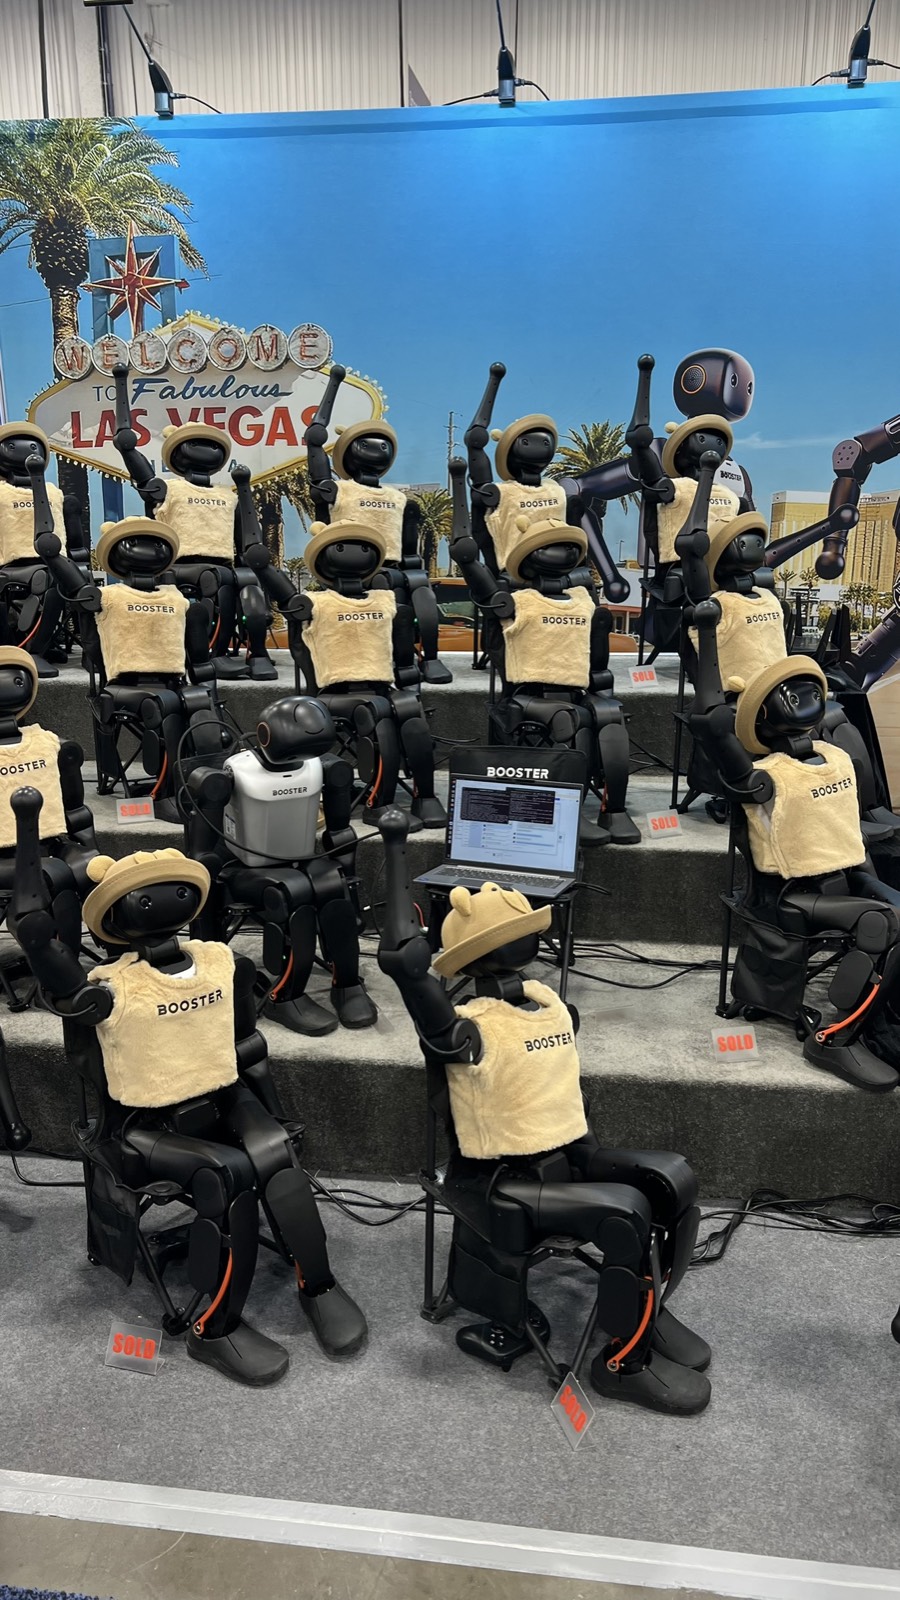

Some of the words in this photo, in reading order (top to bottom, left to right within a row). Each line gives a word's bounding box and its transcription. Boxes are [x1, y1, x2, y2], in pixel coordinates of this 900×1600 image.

[62, 332, 319, 370] WELCOME
[92, 386, 117, 401] TO
[131, 375, 293, 405] Fabulous
[70, 408, 151, 449] LAS
[188, 497, 227, 507] BOOSTER
[360, 500, 396, 509] BOOSTER
[520, 499, 559, 508] BOOSTER
[709, 498, 732, 506] OSTER
[127, 604, 175, 614] BOOSTER
[338, 612, 384, 621] BOOSTER
[542, 616, 587, 626] BOOSTER
[632, 670, 655, 683] SOLD
[0, 759, 47, 775] OOSTER
[486, 766, 549, 779] BOOSTER
[272, 786, 308, 796] BOOSTER
[811, 777, 853, 799] BOOSTER
[120, 803, 151, 817] SOLD
[650, 815, 679, 831] SOLD
[157, 989, 223, 1015] BOOSTER
[524, 1032, 573, 1052] BOOSTER
[717, 1034, 754, 1052] SOLD
[112, 1332, 156, 1360] SOLD
[559, 1384, 587, 1433] SOLD
